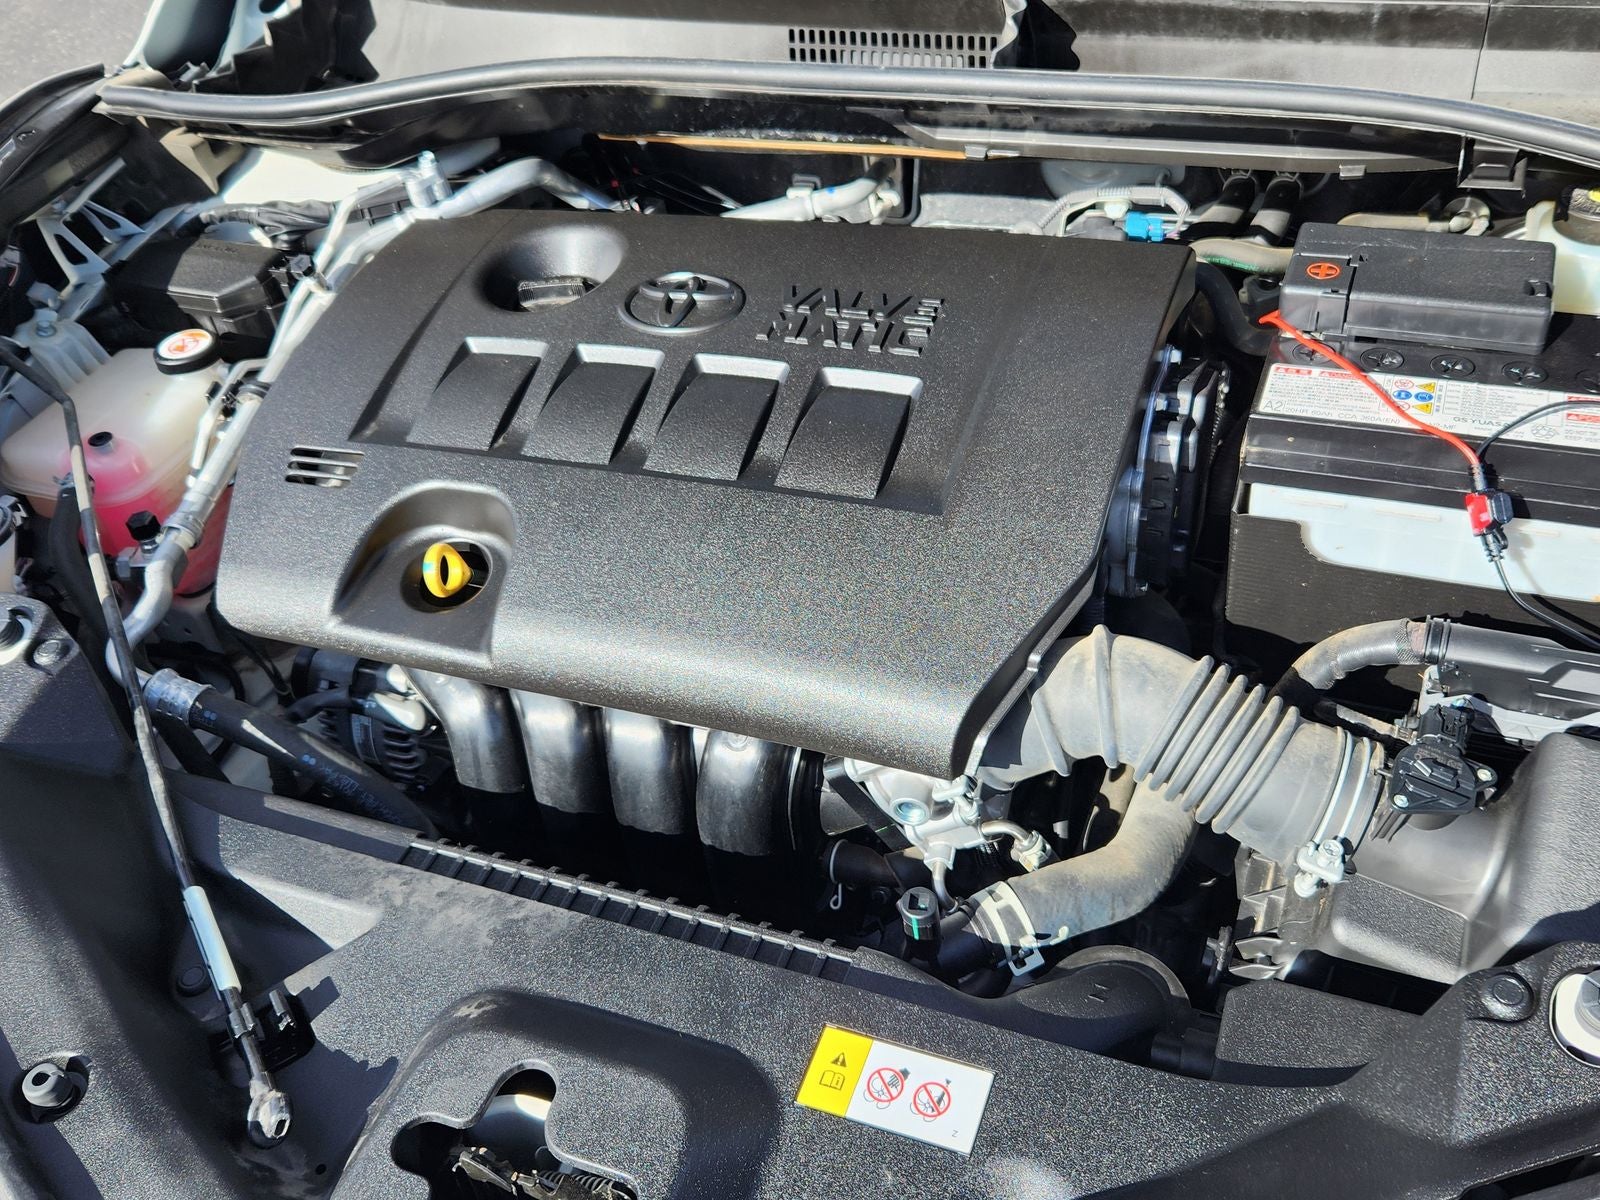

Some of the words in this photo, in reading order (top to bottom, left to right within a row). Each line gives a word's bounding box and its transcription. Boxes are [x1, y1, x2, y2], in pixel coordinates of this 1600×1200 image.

[783, 284, 945, 327] VALVE
[755, 311, 932, 358] MATIC
[1263, 400, 1283, 412] A2
[952, 1130, 959, 1138] Z
